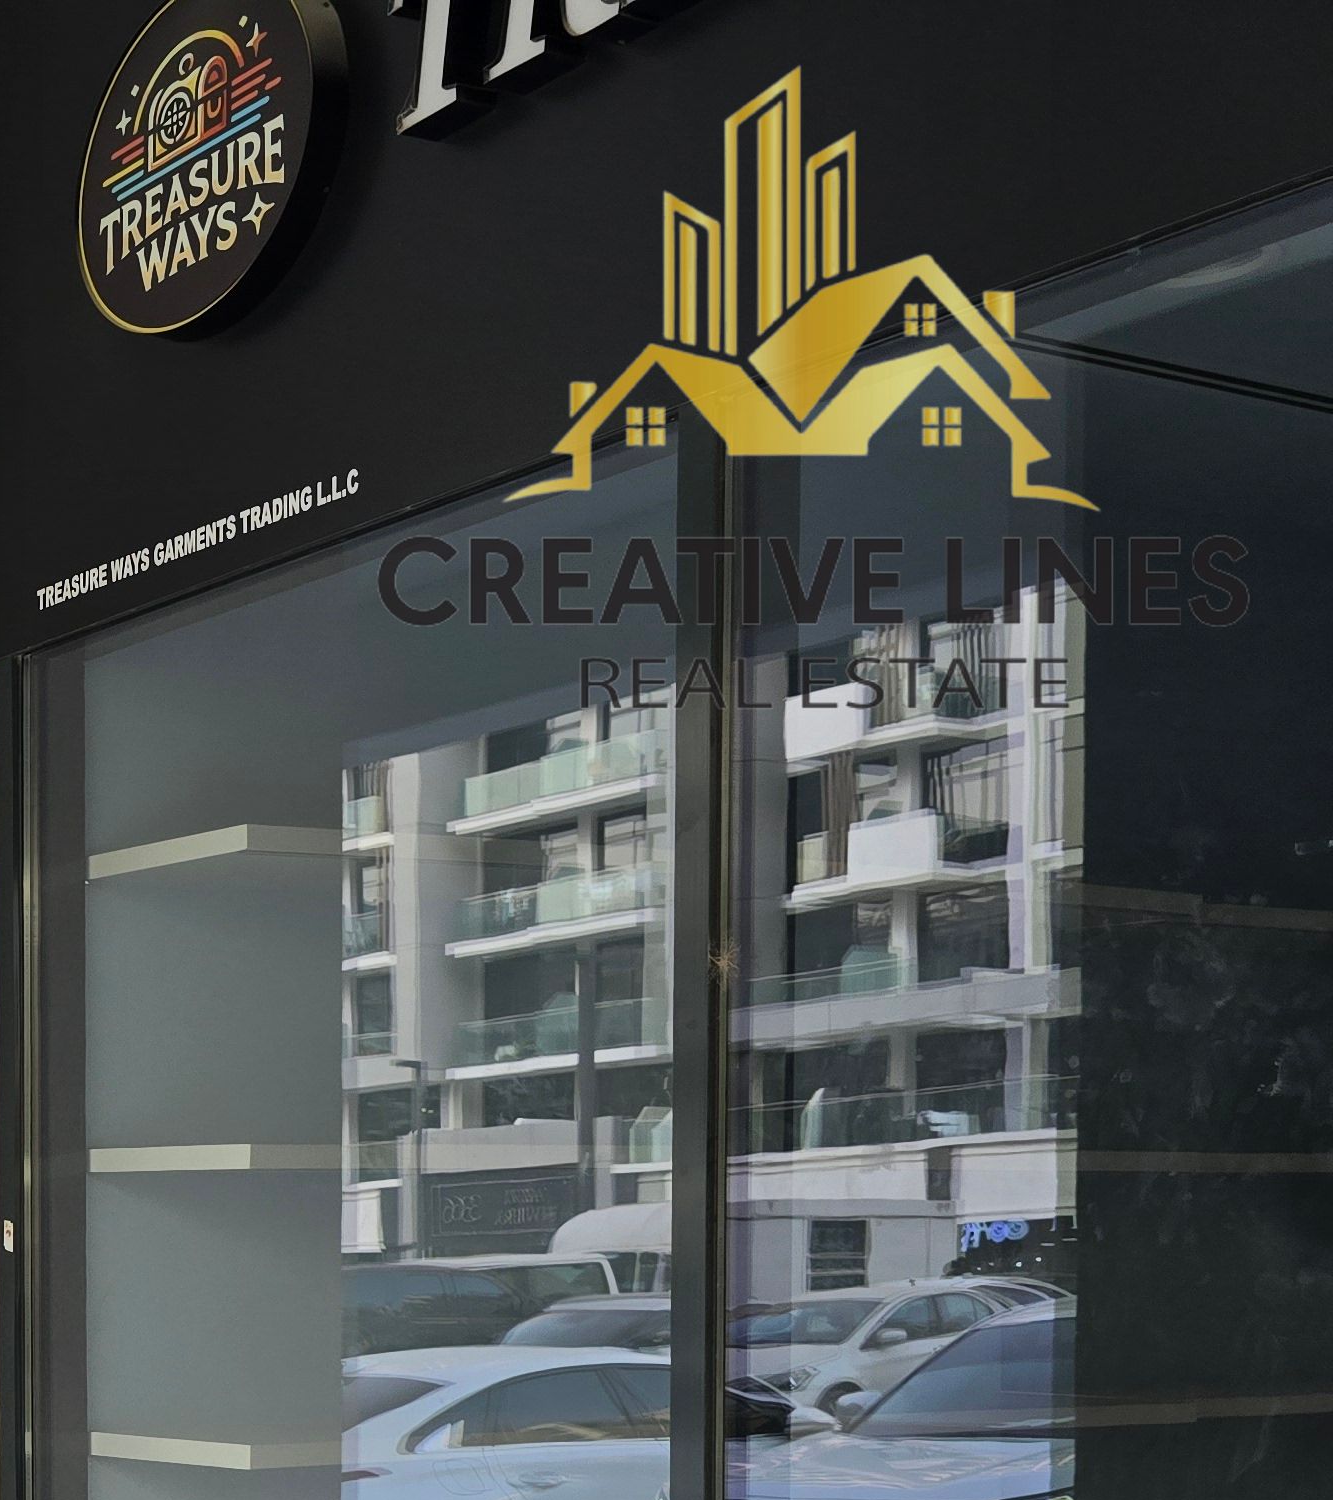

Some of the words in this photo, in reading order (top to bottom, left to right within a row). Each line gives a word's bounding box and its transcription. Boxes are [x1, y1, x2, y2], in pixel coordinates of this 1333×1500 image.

[99, 113, 285, 276] TREASURE
[136, 201, 238, 292] WAYS
[36, 564, 107, 610] TREASURE
[110, 548, 150, 585] WAYS
[153, 514, 236, 566] GARMENTS
[240, 486, 312, 534] TRADING
[316, 468, 359, 506] L.L.C
